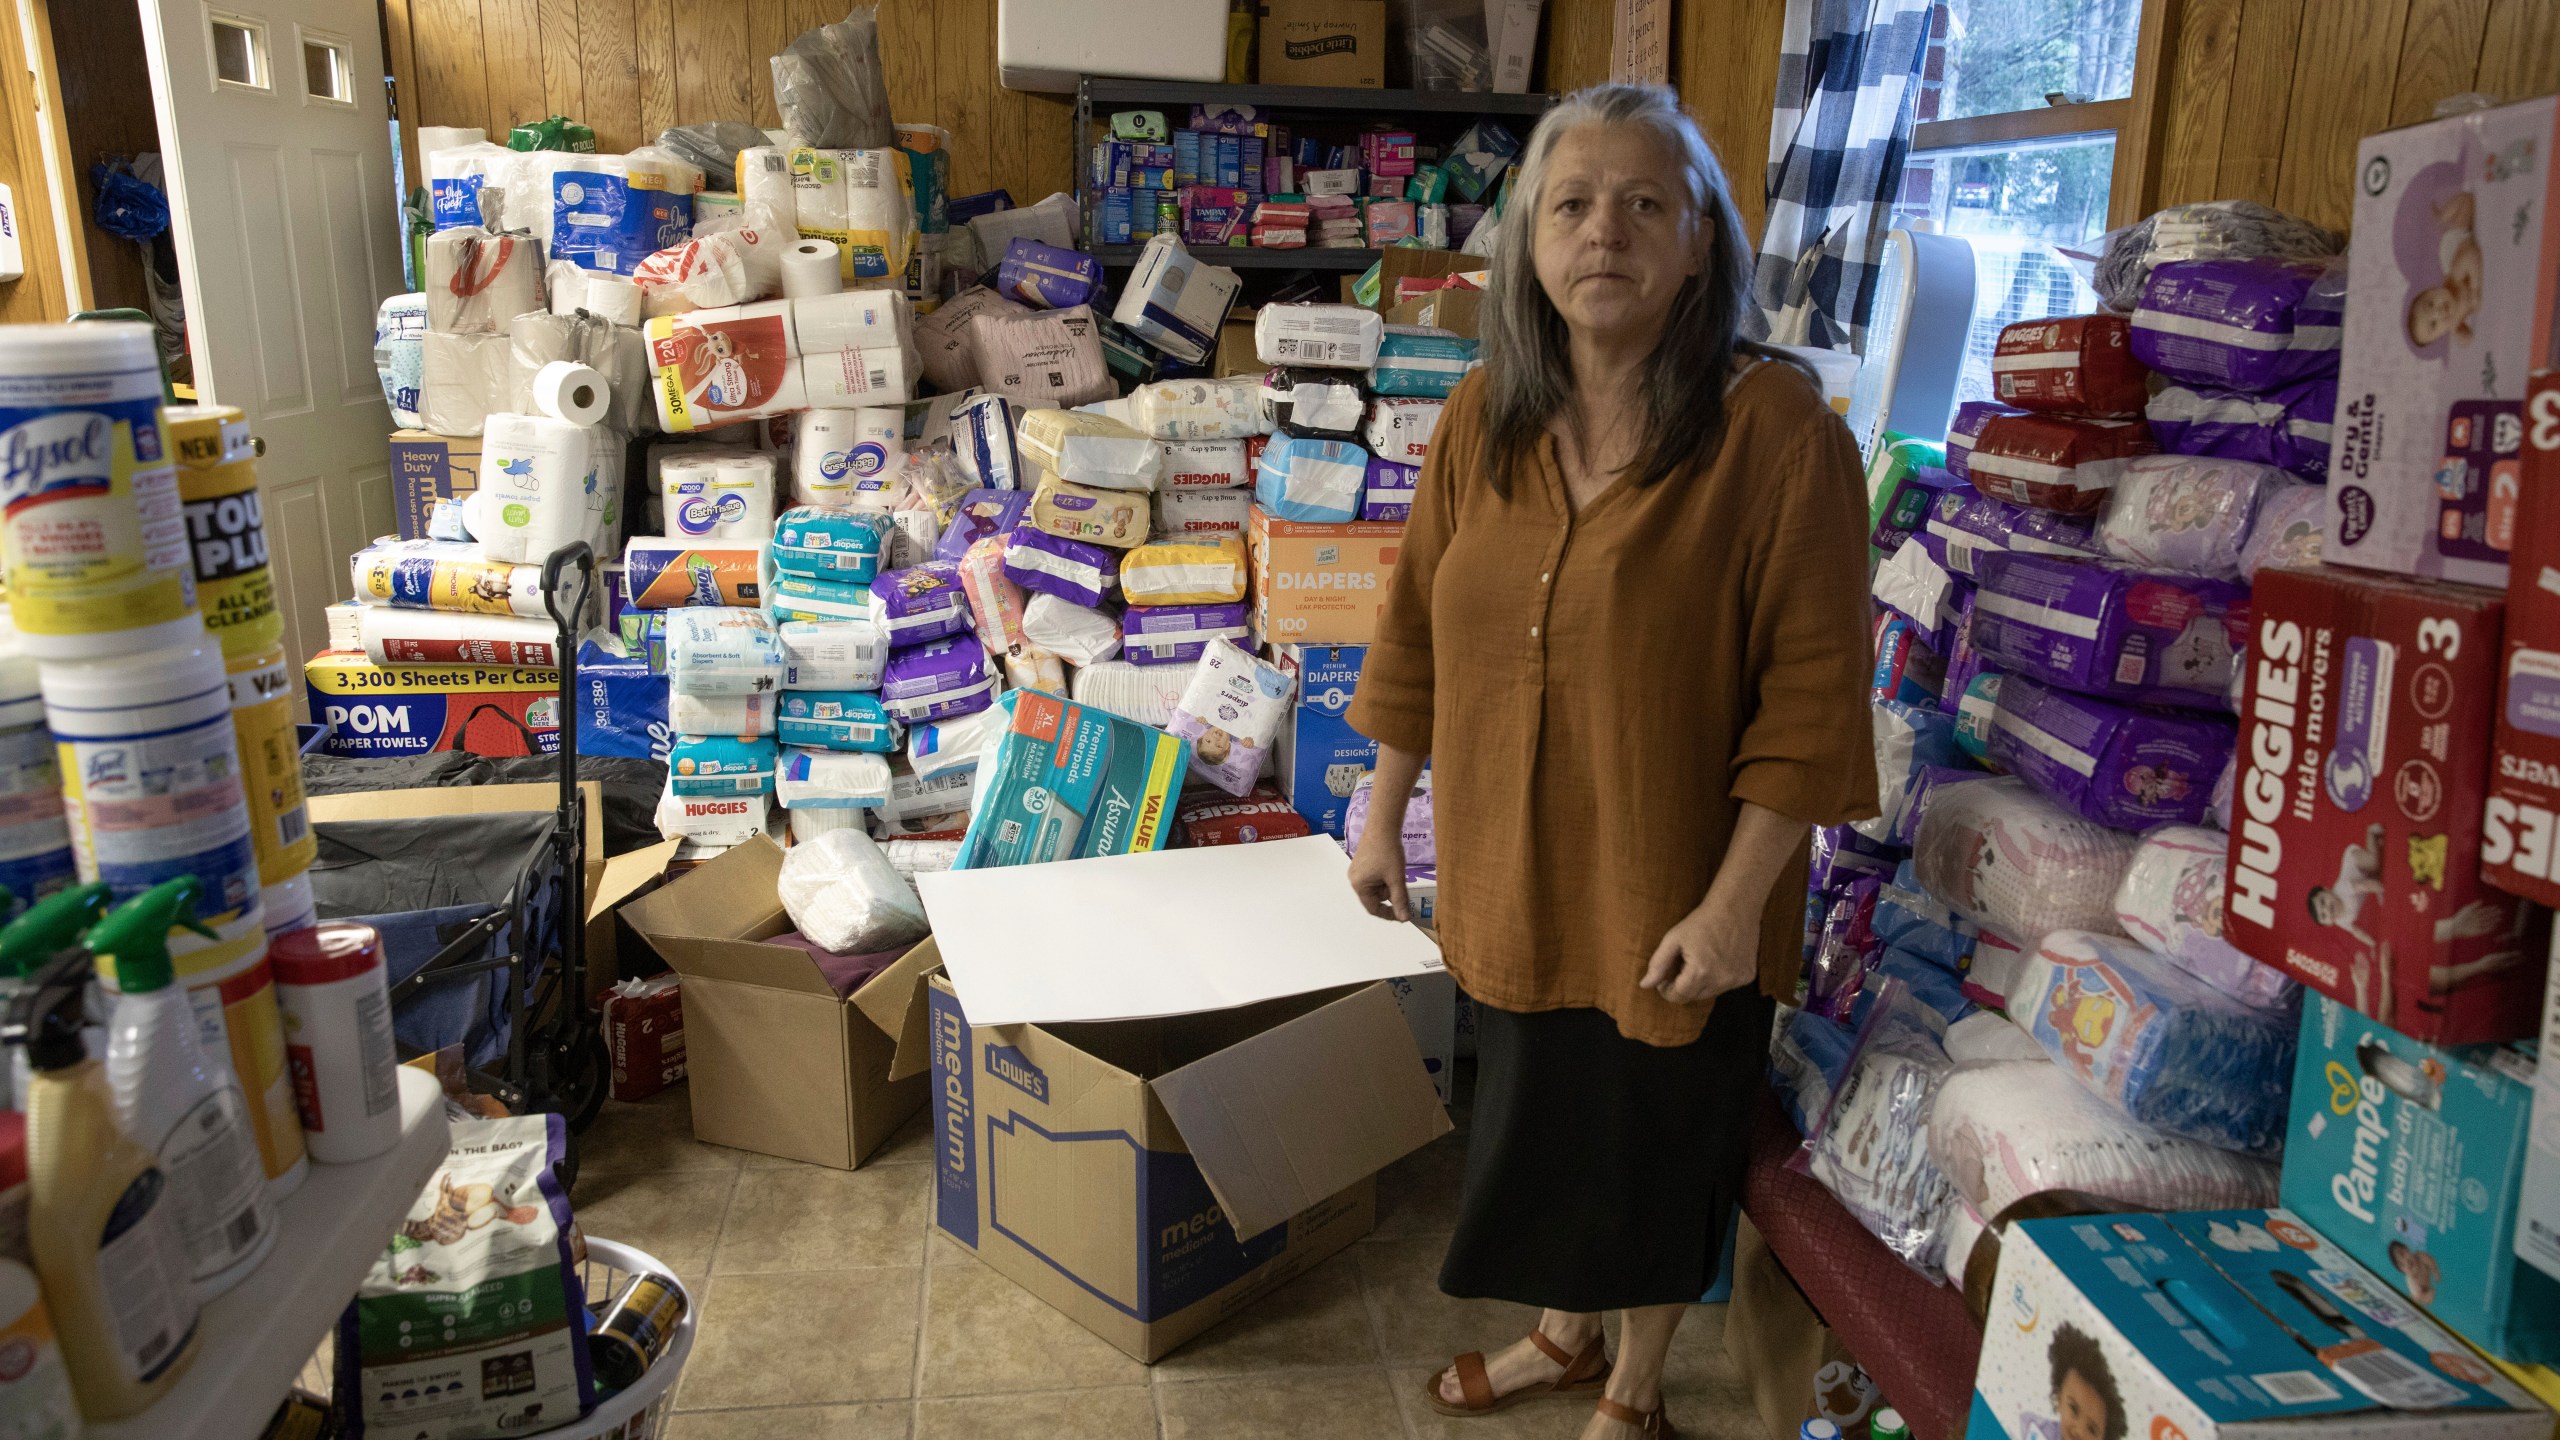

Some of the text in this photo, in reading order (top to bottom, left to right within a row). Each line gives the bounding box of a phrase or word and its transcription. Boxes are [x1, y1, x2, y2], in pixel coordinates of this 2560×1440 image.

[1287, 22, 1357, 31] Unwrap A Smile
[1289, 39, 1353, 54] Little Debbie
[572, 139, 594, 152] 12 ROLLS
[671, 205, 688, 229] Our
[1195, 208, 1227, 217] TAMPAX
[1073, 328, 1086, 337] XL
[2001, 327, 2045, 344] HUGGIES
[660, 340, 677, 365] 120
[1022, 348, 1076, 361] Underwear
[723, 362, 738, 404] Ultra Strong
[2065, 371, 2074, 387] 2
[668, 374, 684, 415] 30 MEGA
[2530, 391, 2560, 451] 3
[2340, 400, 2360, 473] Dry &
[2356, 392, 2376, 480] Gentle
[2373, 413, 2385, 461] Diapers
[0, 420, 103, 493] Lysol
[179, 437, 219, 459] NEW
[1209, 446, 1228, 454] snug
[402, 452, 439, 462] Heavy
[825, 457, 874, 472] Bath Tissue
[404, 463, 431, 473] Duty
[1174, 472, 1231, 486] HUGGIES
[408, 478, 416, 498] Para
[1177, 494, 1183, 502] 3
[690, 502, 741, 519] Bath Tissue
[1897, 508, 1916, 524] 5
[1053, 519, 1104, 536] cuties
[1184, 520, 1240, 531] HUGGIES
[834, 541, 863, 549] diapers
[1277, 572, 1377, 590] DIAPERS
[217, 592, 248, 610] ALL
[1276, 618, 1308, 631] 100
[2418, 617, 2461, 661] 3
[1209, 658, 1221, 669] 28
[336, 669, 560, 690] 3,300 Sheets Per Case
[1308, 671, 1360, 683] DIAPERS
[592, 680, 605, 707] 380
[1220, 690, 1249, 708] diapers
[1329, 692, 1338, 705] 6
[326, 705, 410, 734] POM
[595, 710, 607, 727] 30
[845, 711, 875, 720] diapers
[1042, 712, 1055, 729] XL
[2294, 627, 2331, 821] little movers
[330, 735, 428, 751] PAPER TOWELS
[1083, 723, 1105, 777] Premium
[1022, 742, 1037, 779] MAXIMUM
[1067, 720, 1092, 784] underpads
[1335, 749, 1370, 757] DESIGNS
[2231, 618, 2303, 930] HUGGIES
[1033, 789, 1048, 811] 30
[686, 802, 748, 817] HUGGIES
[1182, 801, 1298, 823] HUGGIES
[1136, 794, 1161, 848] VALUE
[751, 827, 759, 837] 2
[641, 1018, 653, 1034] 2
[934, 1007, 943, 1065] mediana
[616, 1022, 626, 1068] HUGGIES
[990, 1050, 1044, 1097] LOWE'S
[943, 1011, 967, 1173] medium
[464, 1142, 523, 1155] THE BAG?
[1161, 1232, 1214, 1265] mediana
[425, 1294, 457, 1302] SUPER
